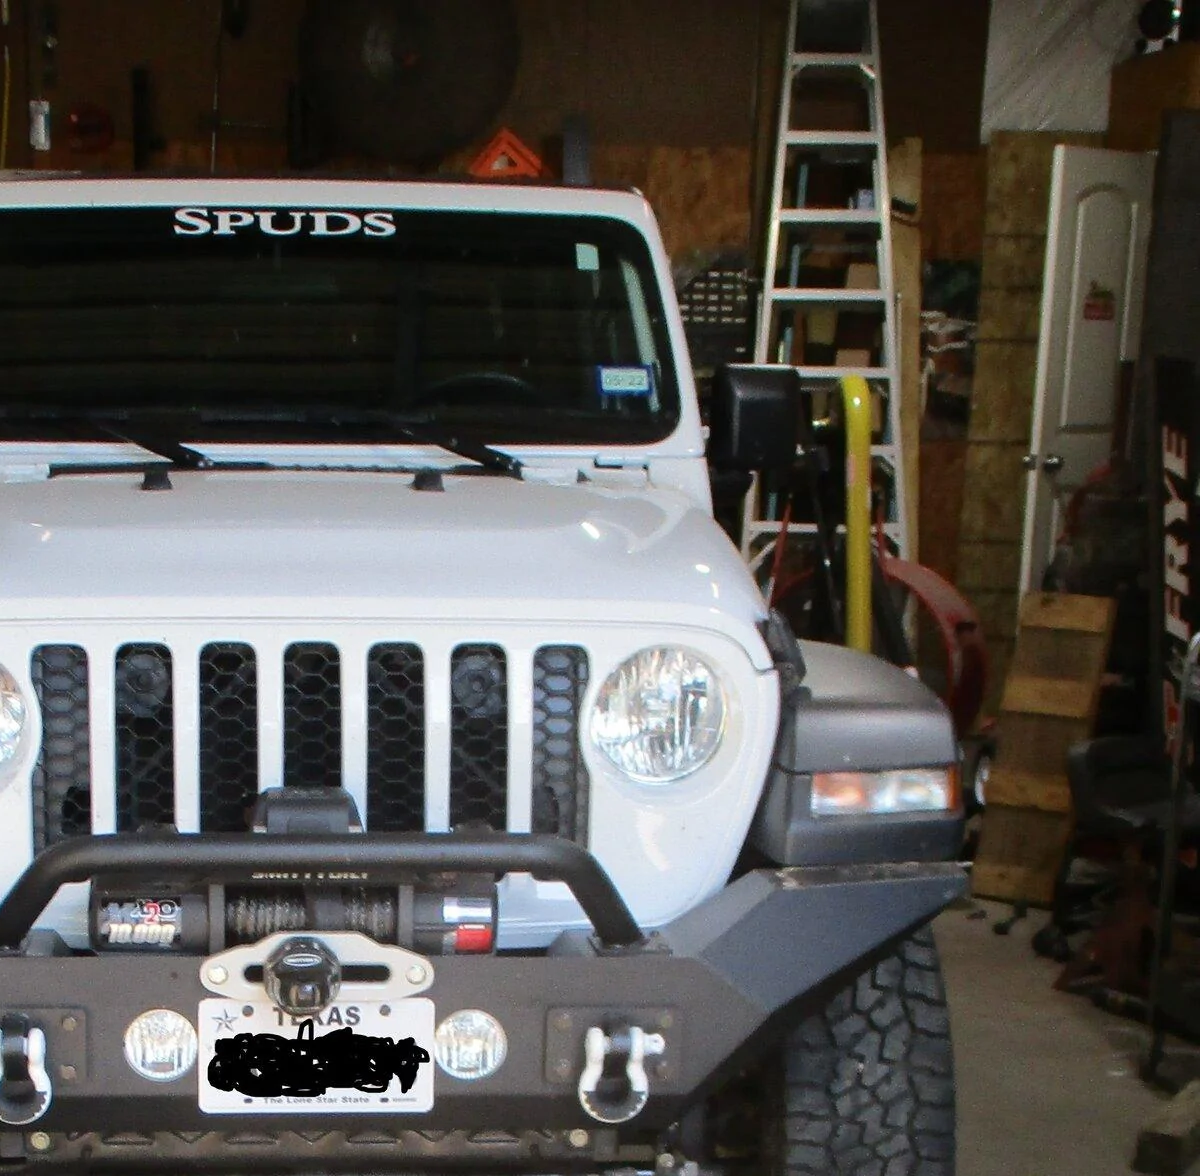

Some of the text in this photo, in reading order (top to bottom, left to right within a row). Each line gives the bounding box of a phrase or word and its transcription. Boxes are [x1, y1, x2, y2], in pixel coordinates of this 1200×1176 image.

[173, 206, 397, 237] SPUDS
[1162, 424, 1191, 640] FRYE
[264, 1096, 370, 1104] The Lone Star State
